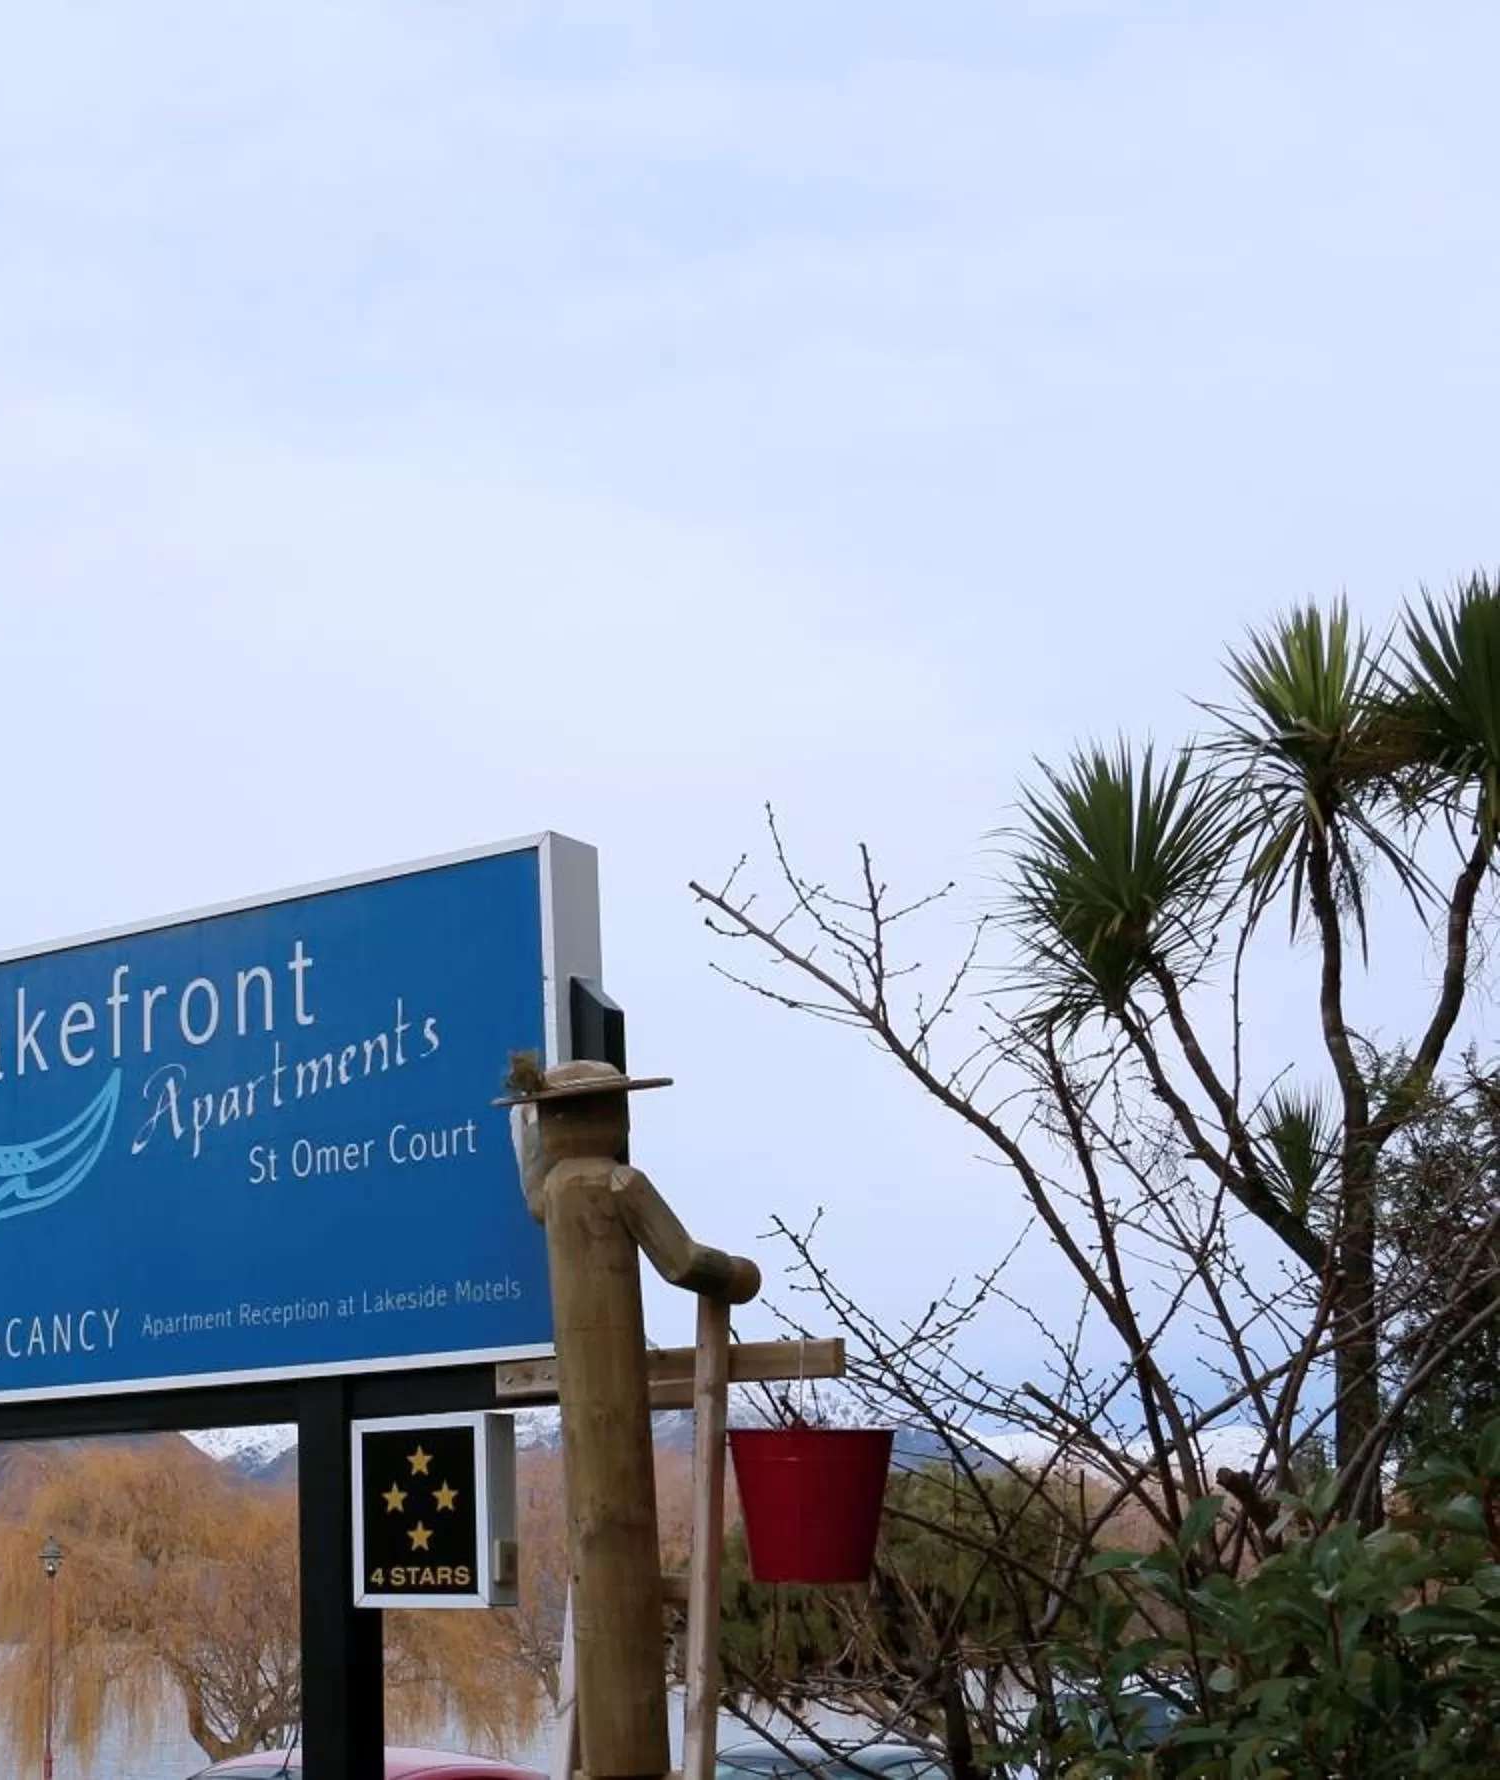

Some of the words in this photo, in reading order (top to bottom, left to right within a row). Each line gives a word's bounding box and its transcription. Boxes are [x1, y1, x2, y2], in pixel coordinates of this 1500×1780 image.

[131, 996, 440, 1160] Apartments
[248, 1145, 277, 1184] St
[291, 1138, 375, 1178] Omer
[388, 1118, 477, 1164] Court
[141, 1308, 232, 1339] Apartment
[239, 1300, 329, 1329] Reception
[337, 1295, 355, 1317] at
[363, 1283, 448, 1314] Lakeside
[455, 1275, 522, 1303] Motels
[370, 1566, 385, 1586] 4
[390, 1565, 472, 1587] STARS
